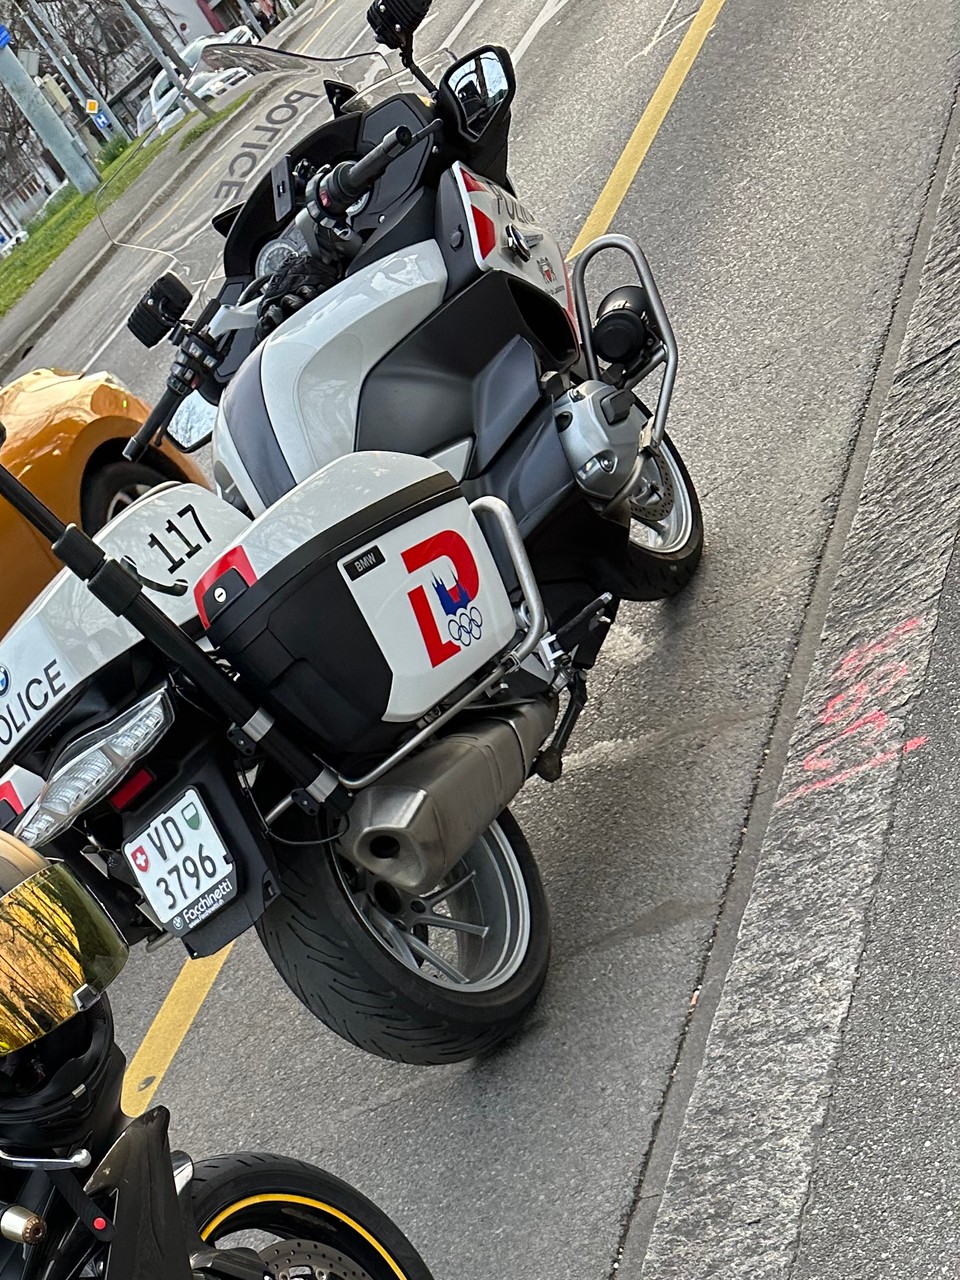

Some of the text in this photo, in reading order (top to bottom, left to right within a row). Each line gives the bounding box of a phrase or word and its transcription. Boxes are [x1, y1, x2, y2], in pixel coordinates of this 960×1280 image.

[147, 503, 212, 574] 117
[353, 552, 377, 573] BMW
[146, 815, 185, 861] VD
[155, 843, 217, 910] 3796
[183, 878, 233, 923] Facchinetti
